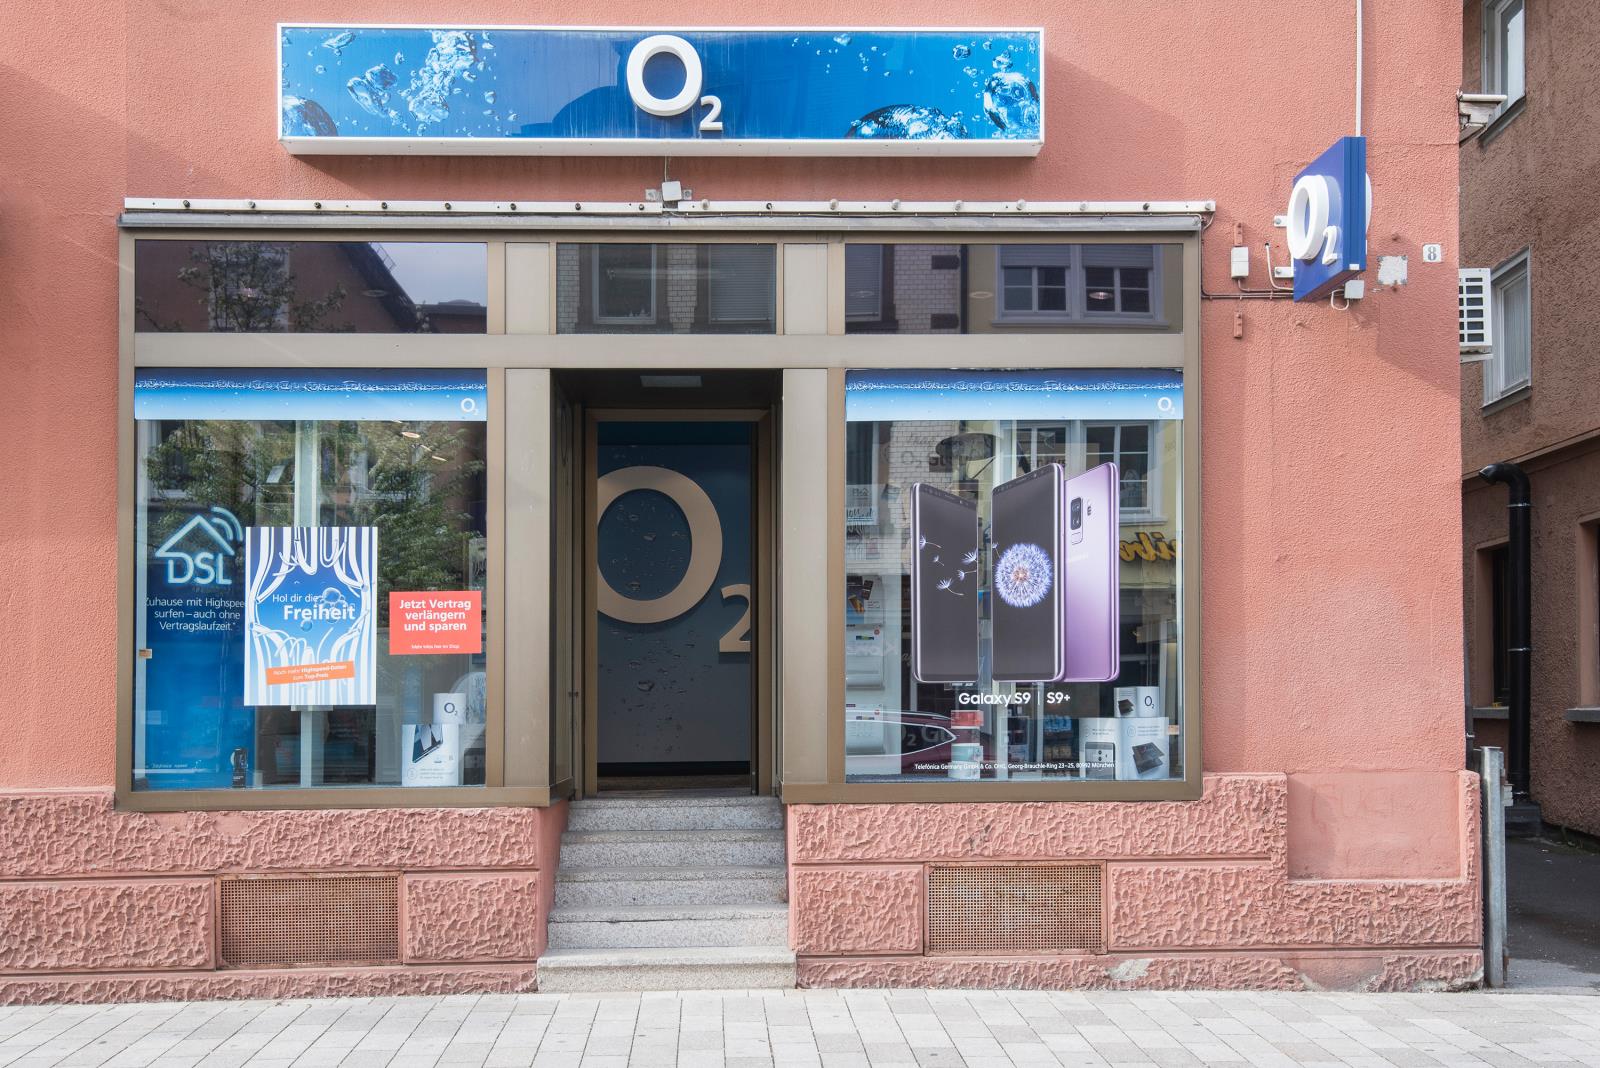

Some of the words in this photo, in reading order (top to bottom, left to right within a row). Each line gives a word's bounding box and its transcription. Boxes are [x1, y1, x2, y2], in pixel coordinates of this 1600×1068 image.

[627, 35, 723, 131] O2
[1286, 174, 1338, 265] O2
[1427, 246, 1437, 261] 8
[167, 552, 232, 585] DSL
[186, 597, 203, 607] mit
[205, 597, 246, 609] Highspee
[272, 594, 288, 603] Hol
[290, 593, 303, 603] dir
[399, 599, 426, 609] Jetzt
[429, 599, 471, 611] Vertrag
[218, 609, 241, 620] ohne
[283, 604, 356, 620] Freiheit
[405, 610, 466, 622] verlängern
[404, 621, 426, 631] und
[429, 622, 467, 633] sparen
[958, 692, 1012, 707] Galaxy
[1014, 692, 1031, 704] S9
[1046, 691, 1071, 704] S9+
[1144, 695, 1155, 709] O2
[444, 702, 458, 716] O2
[1091, 761, 1115, 769] München
